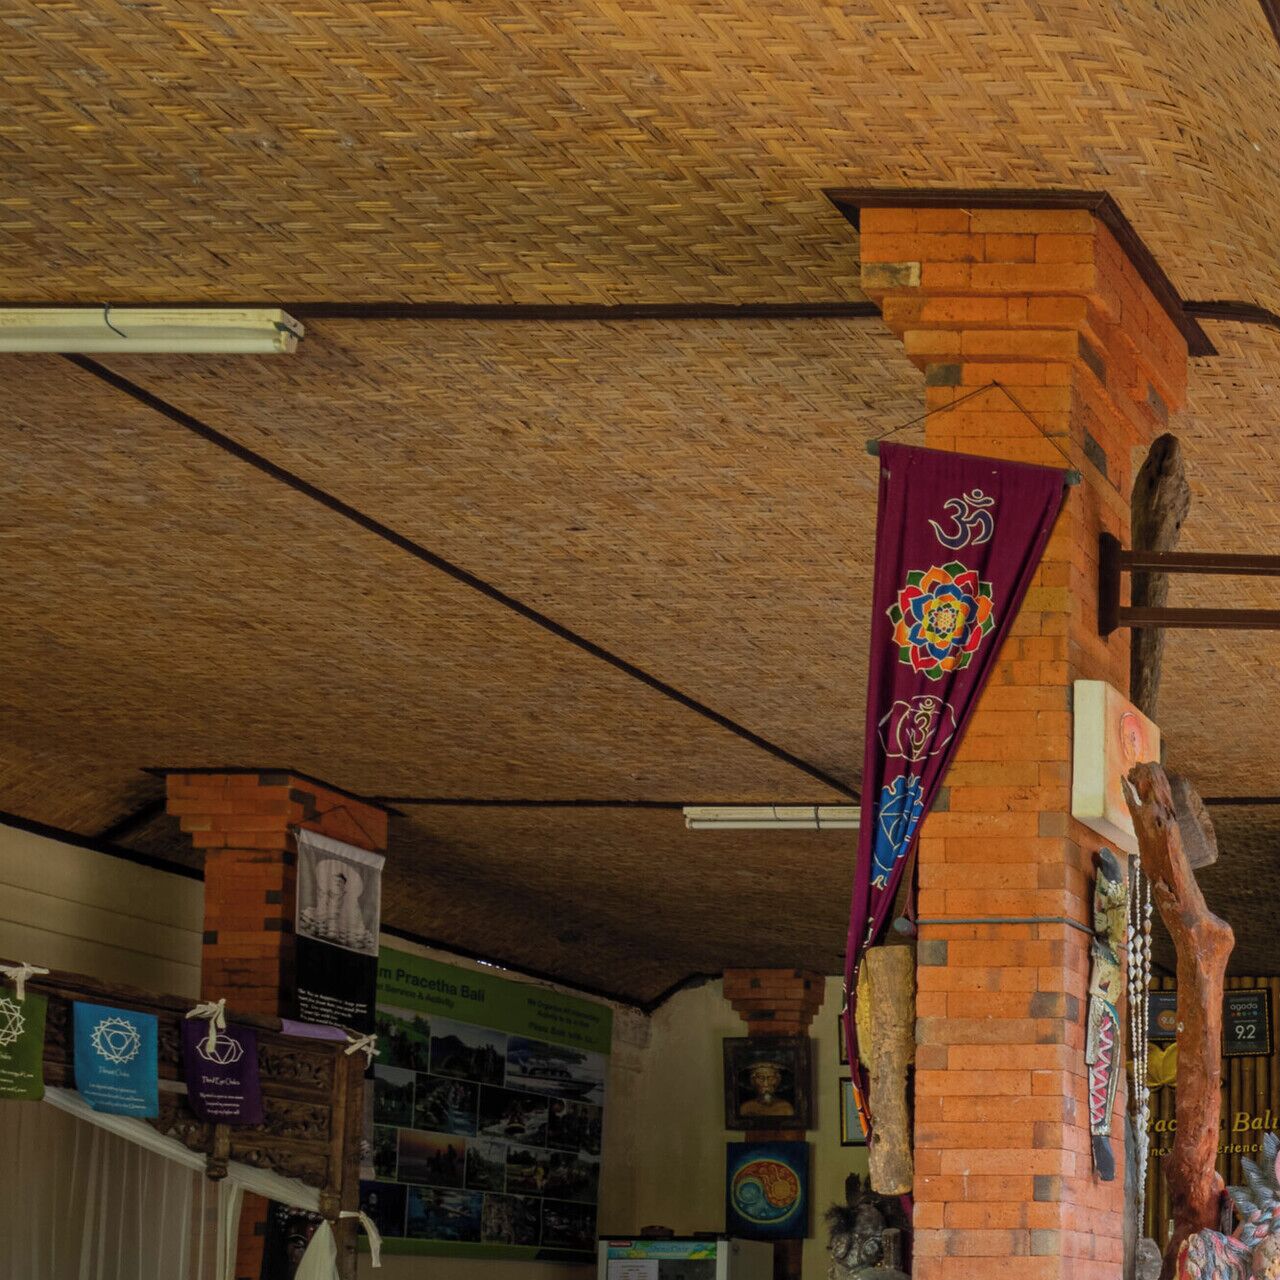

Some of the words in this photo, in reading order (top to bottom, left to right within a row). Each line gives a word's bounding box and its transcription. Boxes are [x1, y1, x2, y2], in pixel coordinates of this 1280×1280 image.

[395, 967, 457, 995] Pracetha
[460, 984, 485, 1002] Bali
[1230, 1002, 1258, 1011] agoda
[1235, 1024, 1256, 1040] 9.2
[1232, 1109, 1279, 1132] Bali
